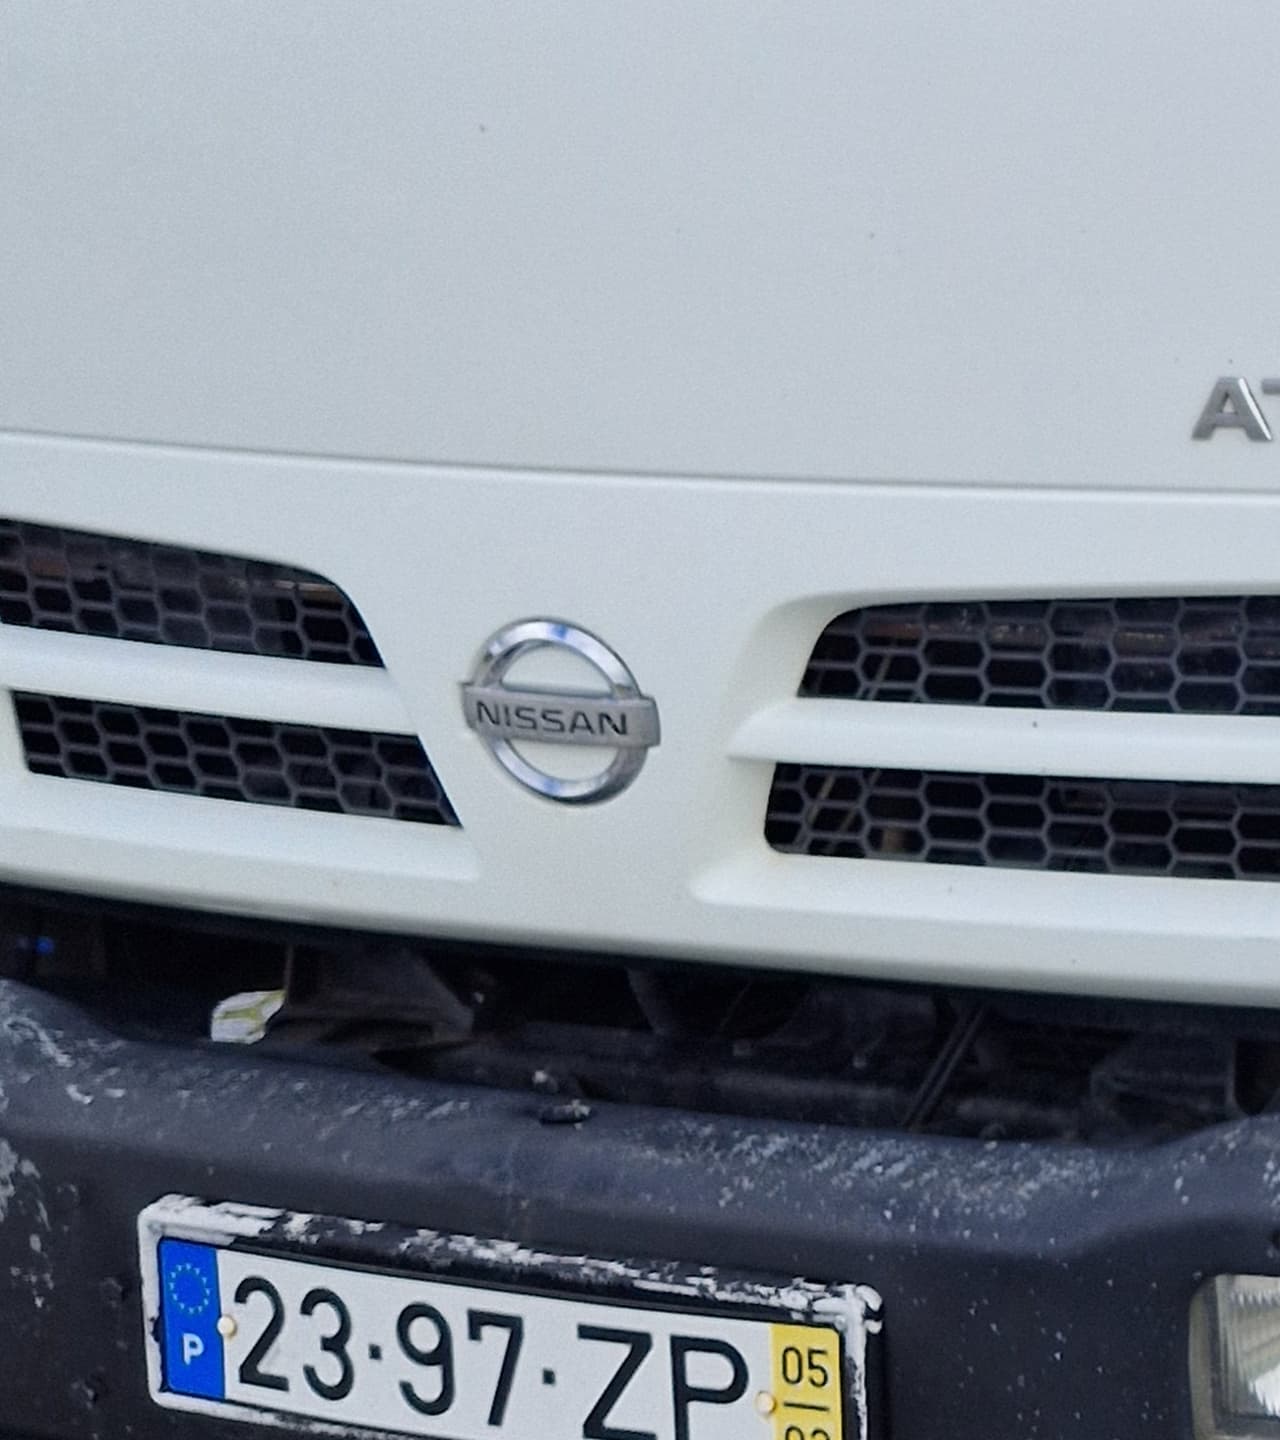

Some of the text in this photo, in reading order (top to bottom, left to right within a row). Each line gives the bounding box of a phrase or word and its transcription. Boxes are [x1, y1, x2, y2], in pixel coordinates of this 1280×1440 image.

[475, 699, 628, 736] NISSAN
[182, 1332, 205, 1366] P
[782, 1346, 829, 1388] 05
